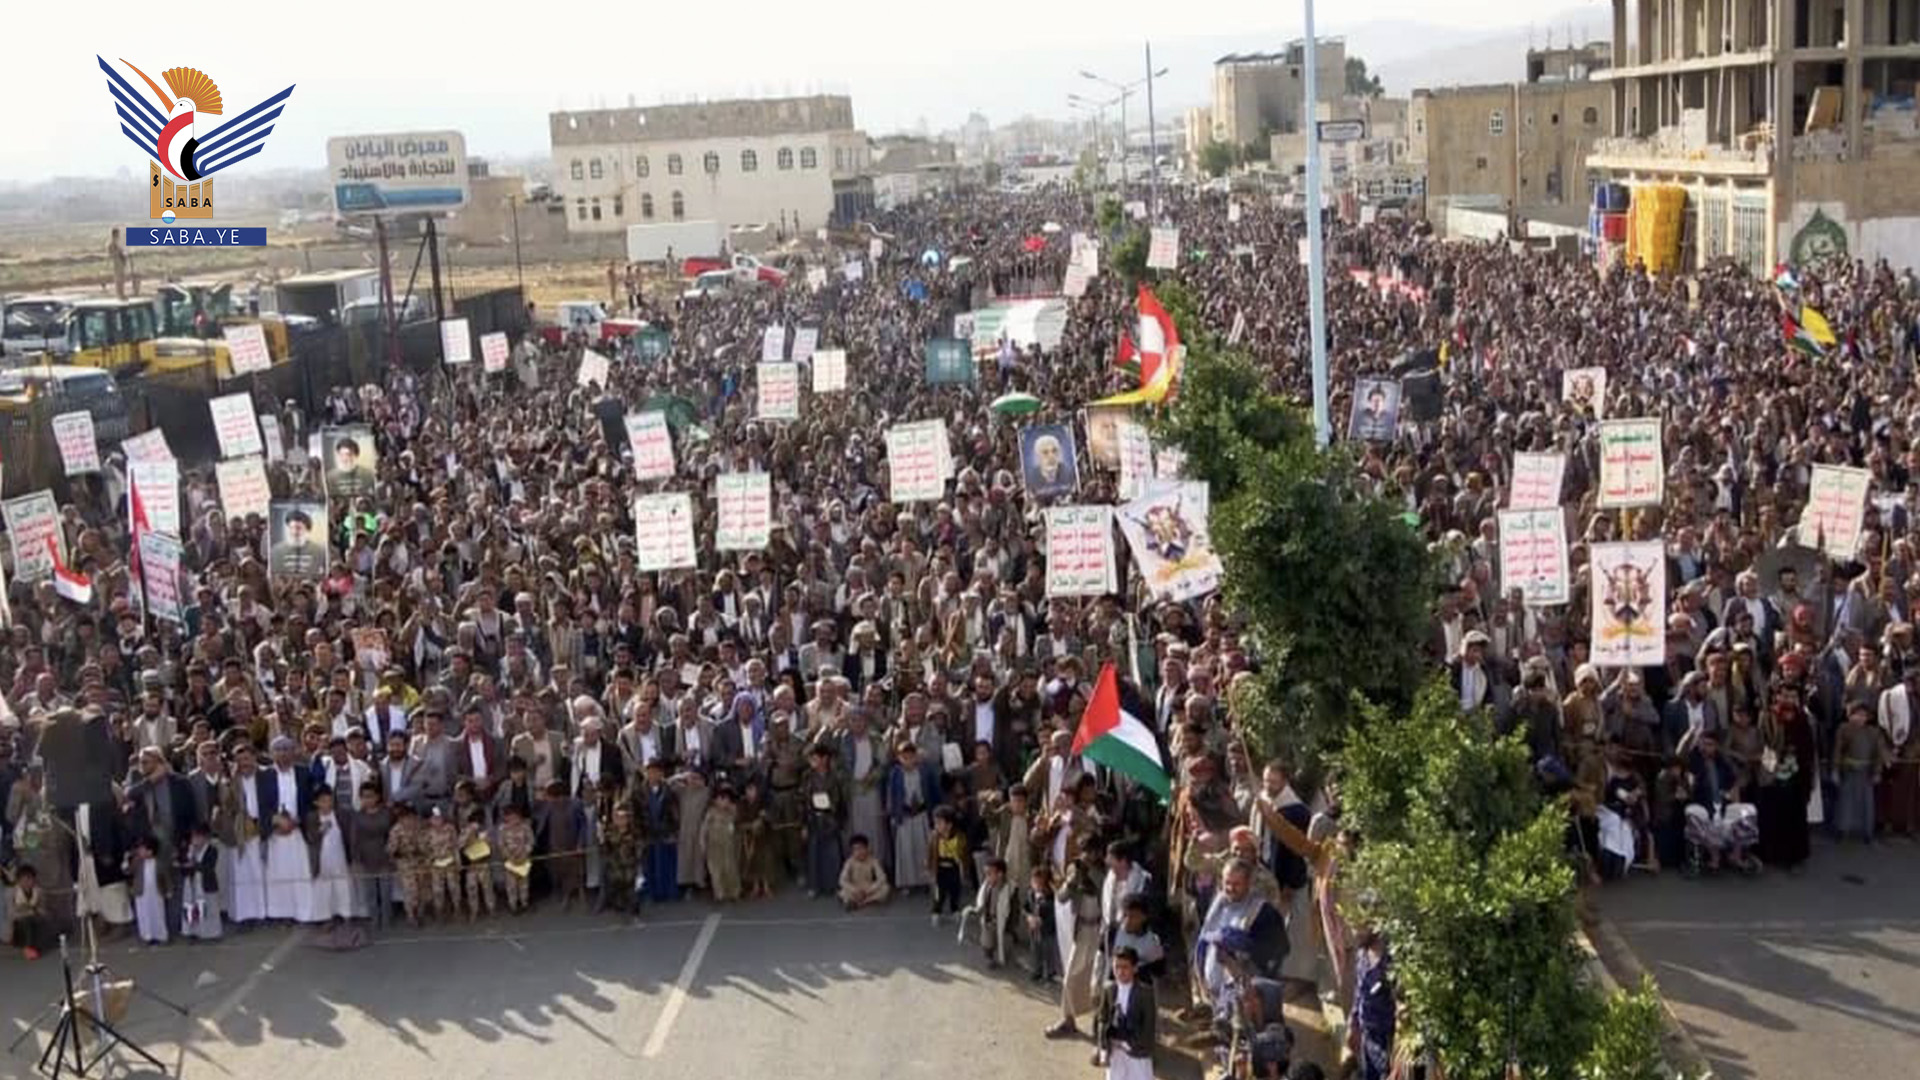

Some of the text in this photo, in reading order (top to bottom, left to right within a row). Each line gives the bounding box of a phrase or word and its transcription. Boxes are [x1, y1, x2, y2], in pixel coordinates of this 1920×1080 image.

[345, 139, 448, 160] معرض اليابان
[409, 160, 455, 178] للتجارة
